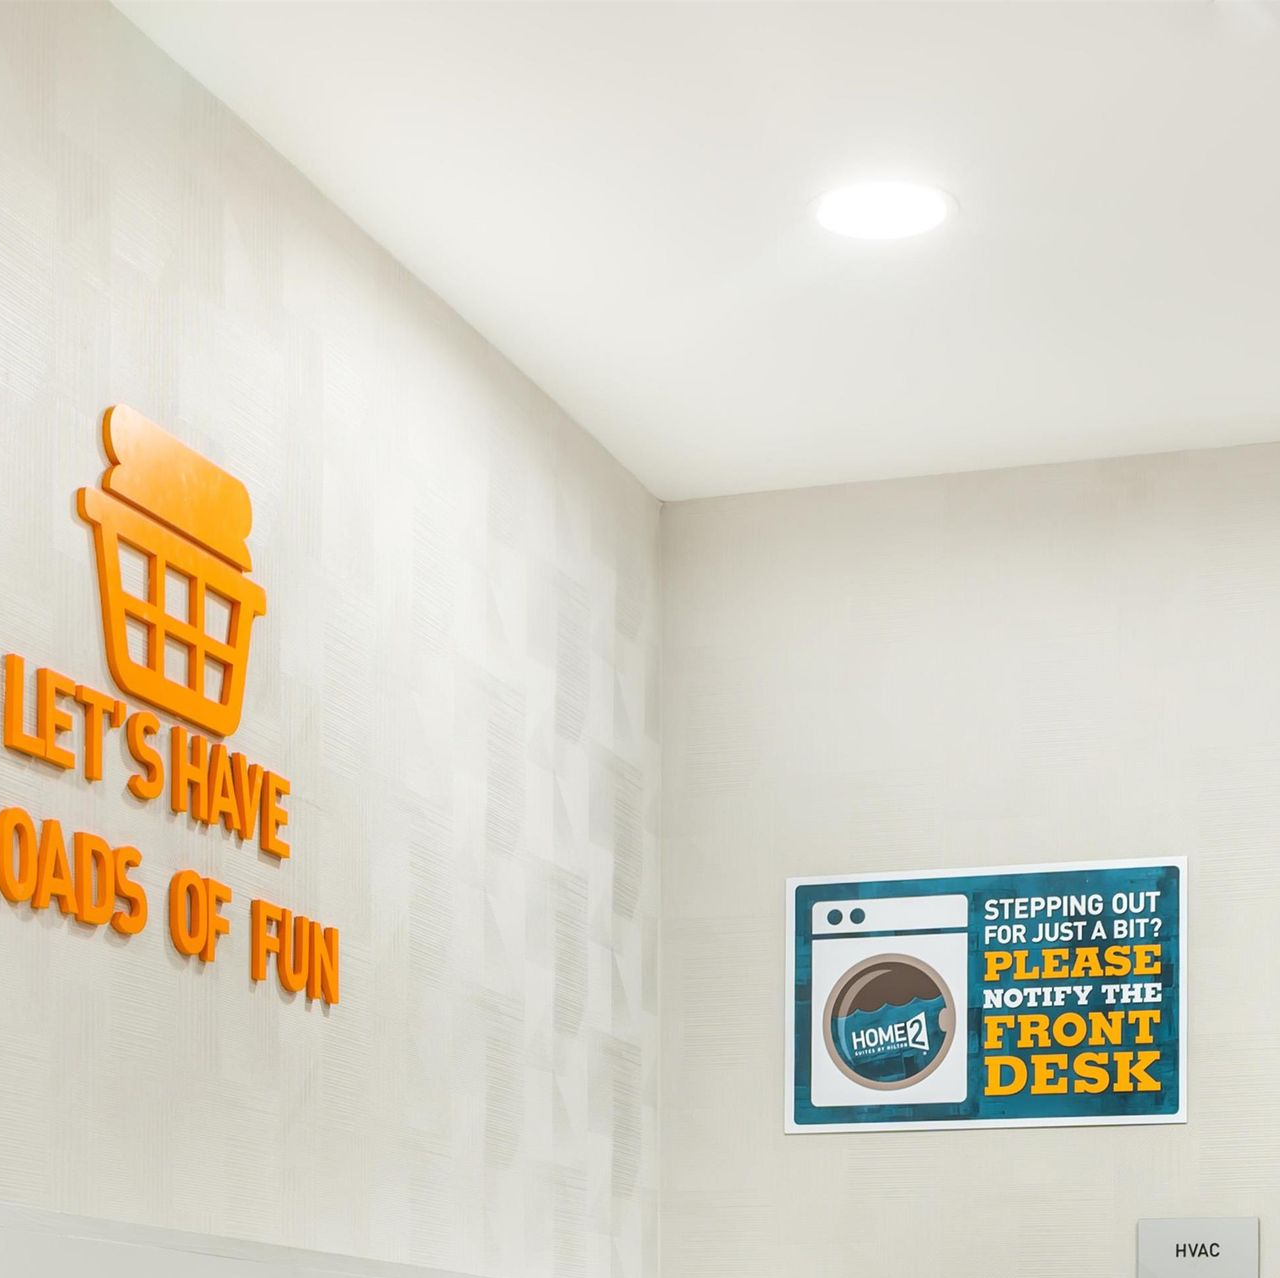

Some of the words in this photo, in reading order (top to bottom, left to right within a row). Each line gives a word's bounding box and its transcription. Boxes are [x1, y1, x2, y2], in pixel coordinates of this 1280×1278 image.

[4, 654, 164, 800] LET'S
[171, 726, 290, 859] HAVE
[984, 894, 1104, 921] STEPPING
[1111, 891, 1161, 913] OUT
[169, 869, 231, 962] OF
[251, 898, 339, 1005] FUN
[984, 923, 1026, 945] FOR
[1031, 921, 1087, 944] JUST
[1091, 920, 1107, 941] A
[1113, 917, 1162, 939] BIT?
[983, 944, 1162, 982] PLEASE
[983, 985, 1093, 1009] NOTIFY
[1101, 982, 1162, 1004] THE
[983, 1009, 1161, 1050] FRONT
[983, 1050, 1161, 1097] DESK
[1175, 1242, 1220, 1258] HVAC
